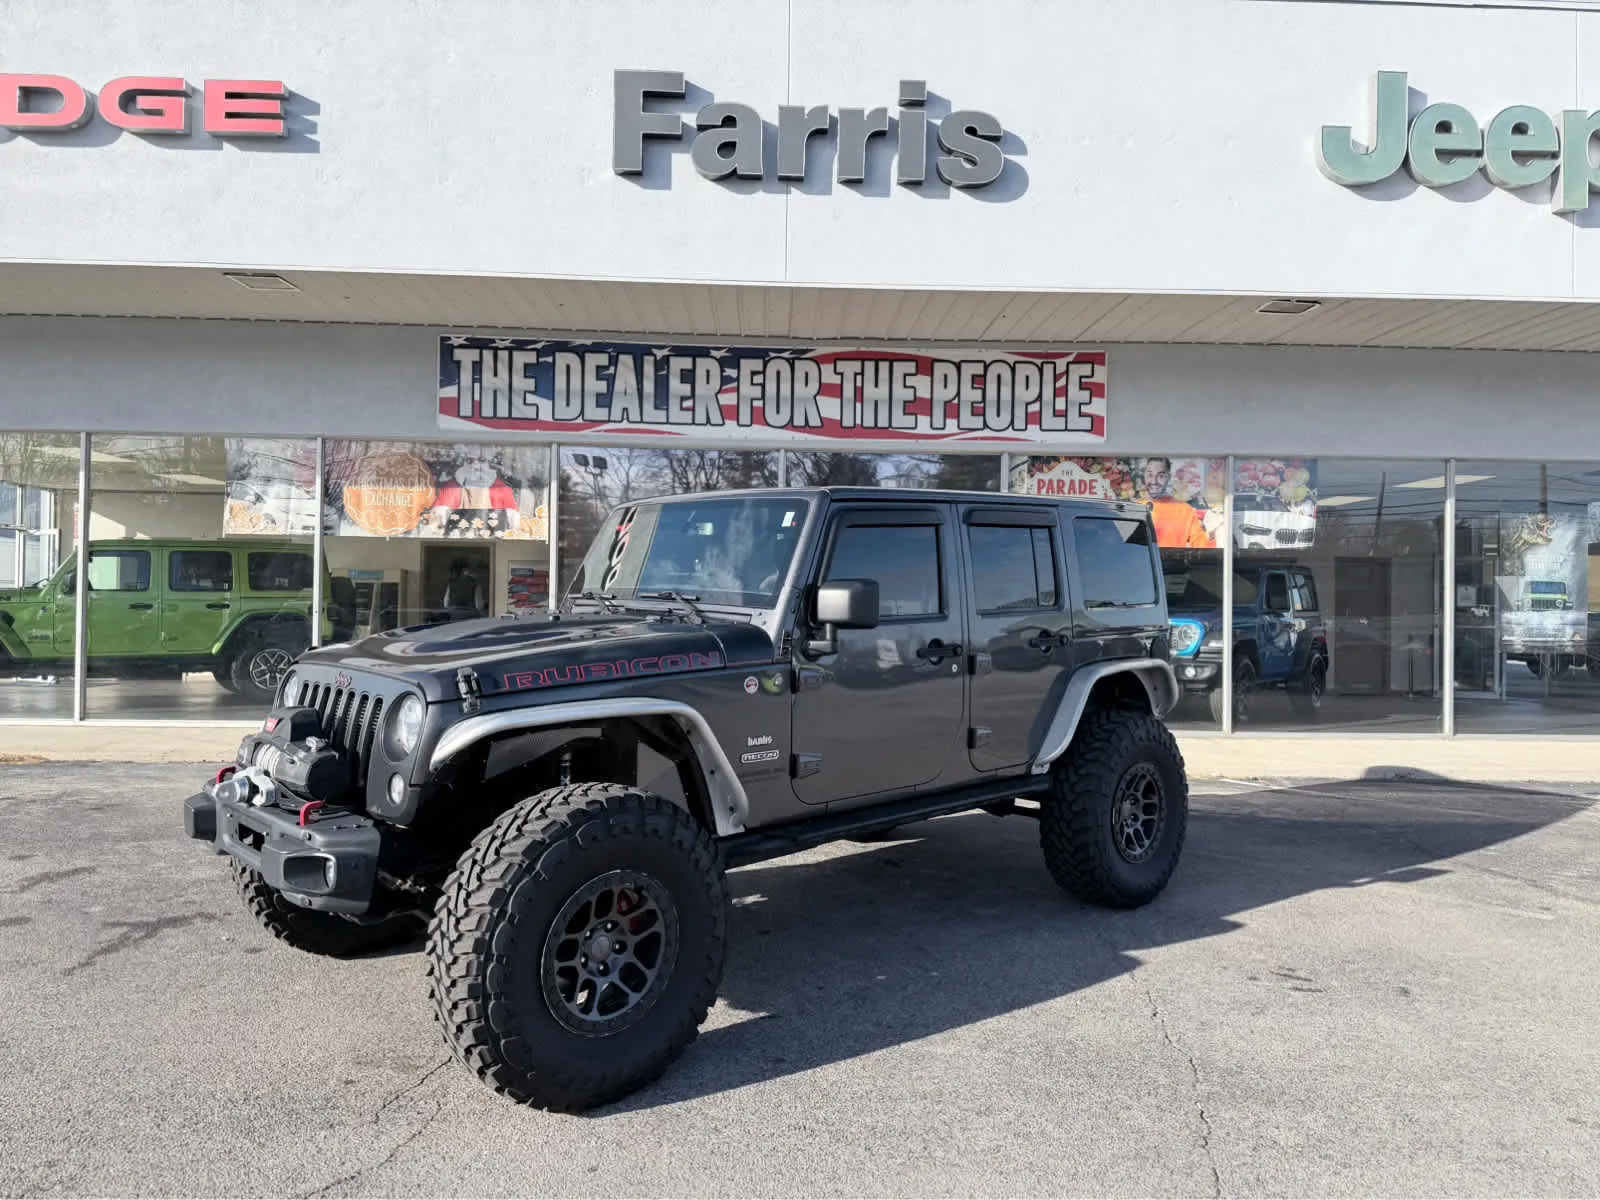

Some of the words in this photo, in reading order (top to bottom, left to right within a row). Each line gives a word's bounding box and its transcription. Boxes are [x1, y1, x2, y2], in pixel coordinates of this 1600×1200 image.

[614, 69, 1004, 188] Farris
[451, 346, 539, 421] THE
[551, 350, 725, 427] DEALER
[736, 356, 824, 429] FOR
[833, 359, 919, 430] THE
[929, 359, 1095, 432] PEOPLE
[365, 493, 414, 507] EXCHANGE
[1037, 478, 1098, 496] PARADE
[503, 651, 722, 691] RUBICON
